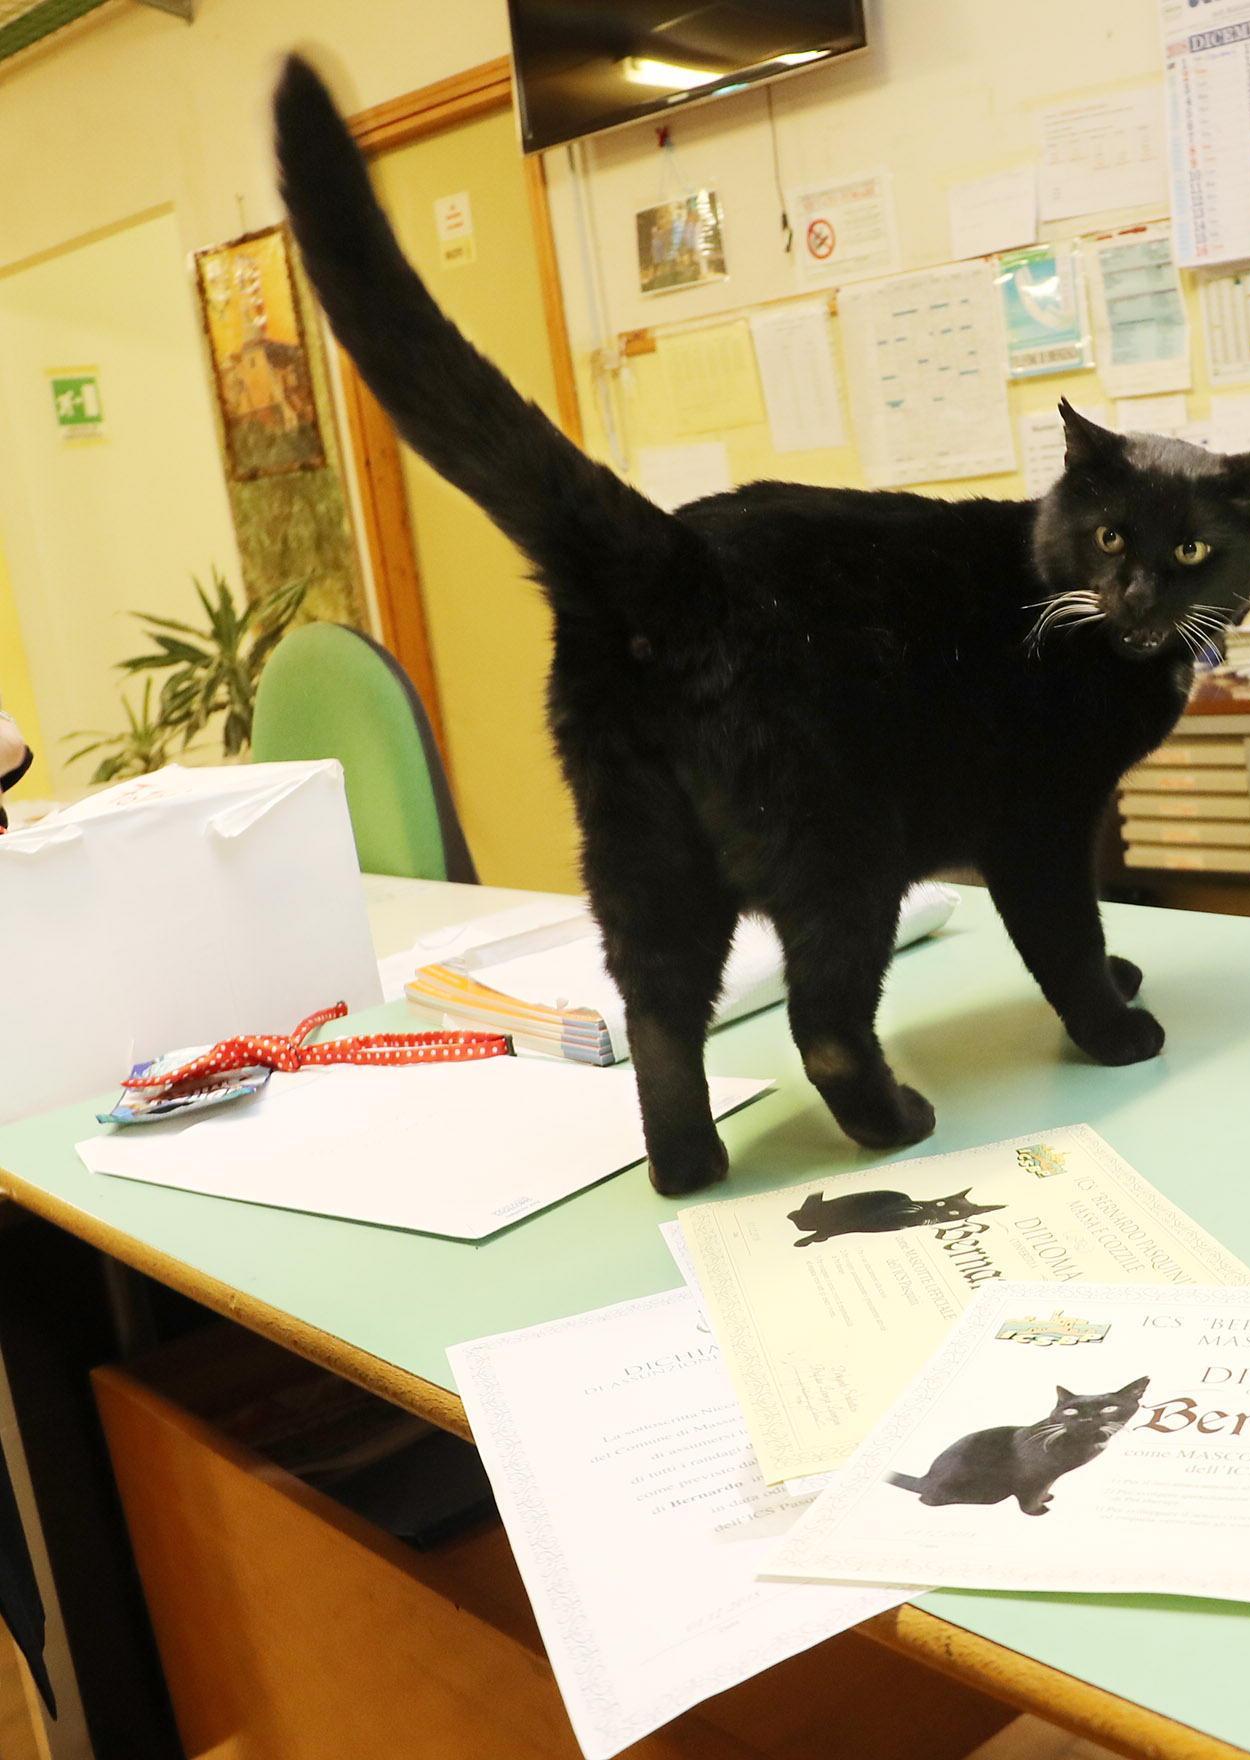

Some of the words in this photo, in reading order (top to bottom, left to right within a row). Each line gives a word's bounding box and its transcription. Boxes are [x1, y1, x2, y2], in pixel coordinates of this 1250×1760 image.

[934, 1219, 1006, 1290] Berna
[1014, 1216, 1084, 1283] DIPLOMA
[1141, 1314, 1185, 1329] ICS
[610, 1354, 718, 1390] ASSUNZION
[589, 1453, 612, 1465] del
[614, 1436, 675, 1456] Comune
[676, 1428, 692, 1439] di
[693, 1417, 737, 1433] Massa
[1122, 1449, 1172, 1459] come
[630, 1475, 645, 1486] di
[648, 1463, 678, 1480] tutti
[690, 1443, 743, 1467] randagi
[635, 1485, 676, 1503] come
[679, 1465, 736, 1489] previsto
[669, 1480, 744, 1508] Bernardo
[779, 1494, 818, 1512] Pasq
